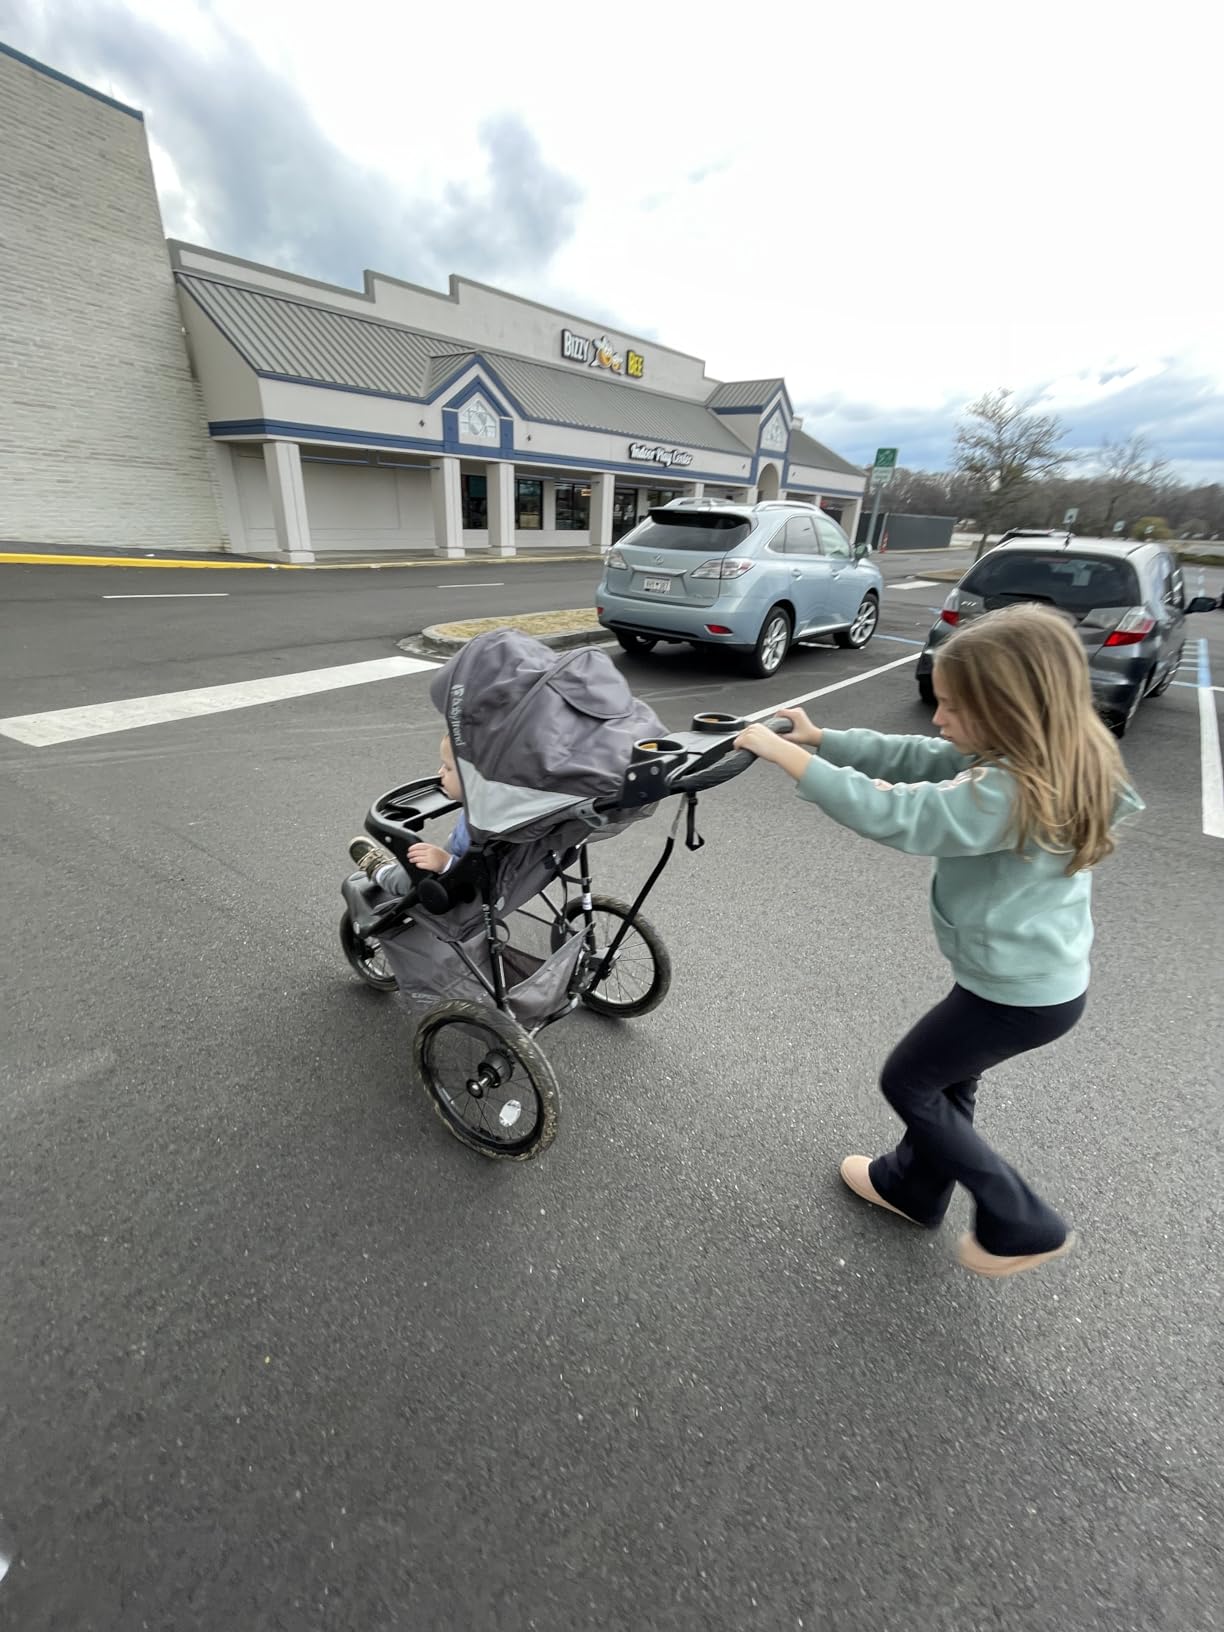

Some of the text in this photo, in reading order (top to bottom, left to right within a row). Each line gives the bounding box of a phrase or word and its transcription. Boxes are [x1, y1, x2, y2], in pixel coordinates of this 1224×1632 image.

[563, 329, 590, 361] BIZZY
[630, 443, 693, 467] Indoor Play Center
